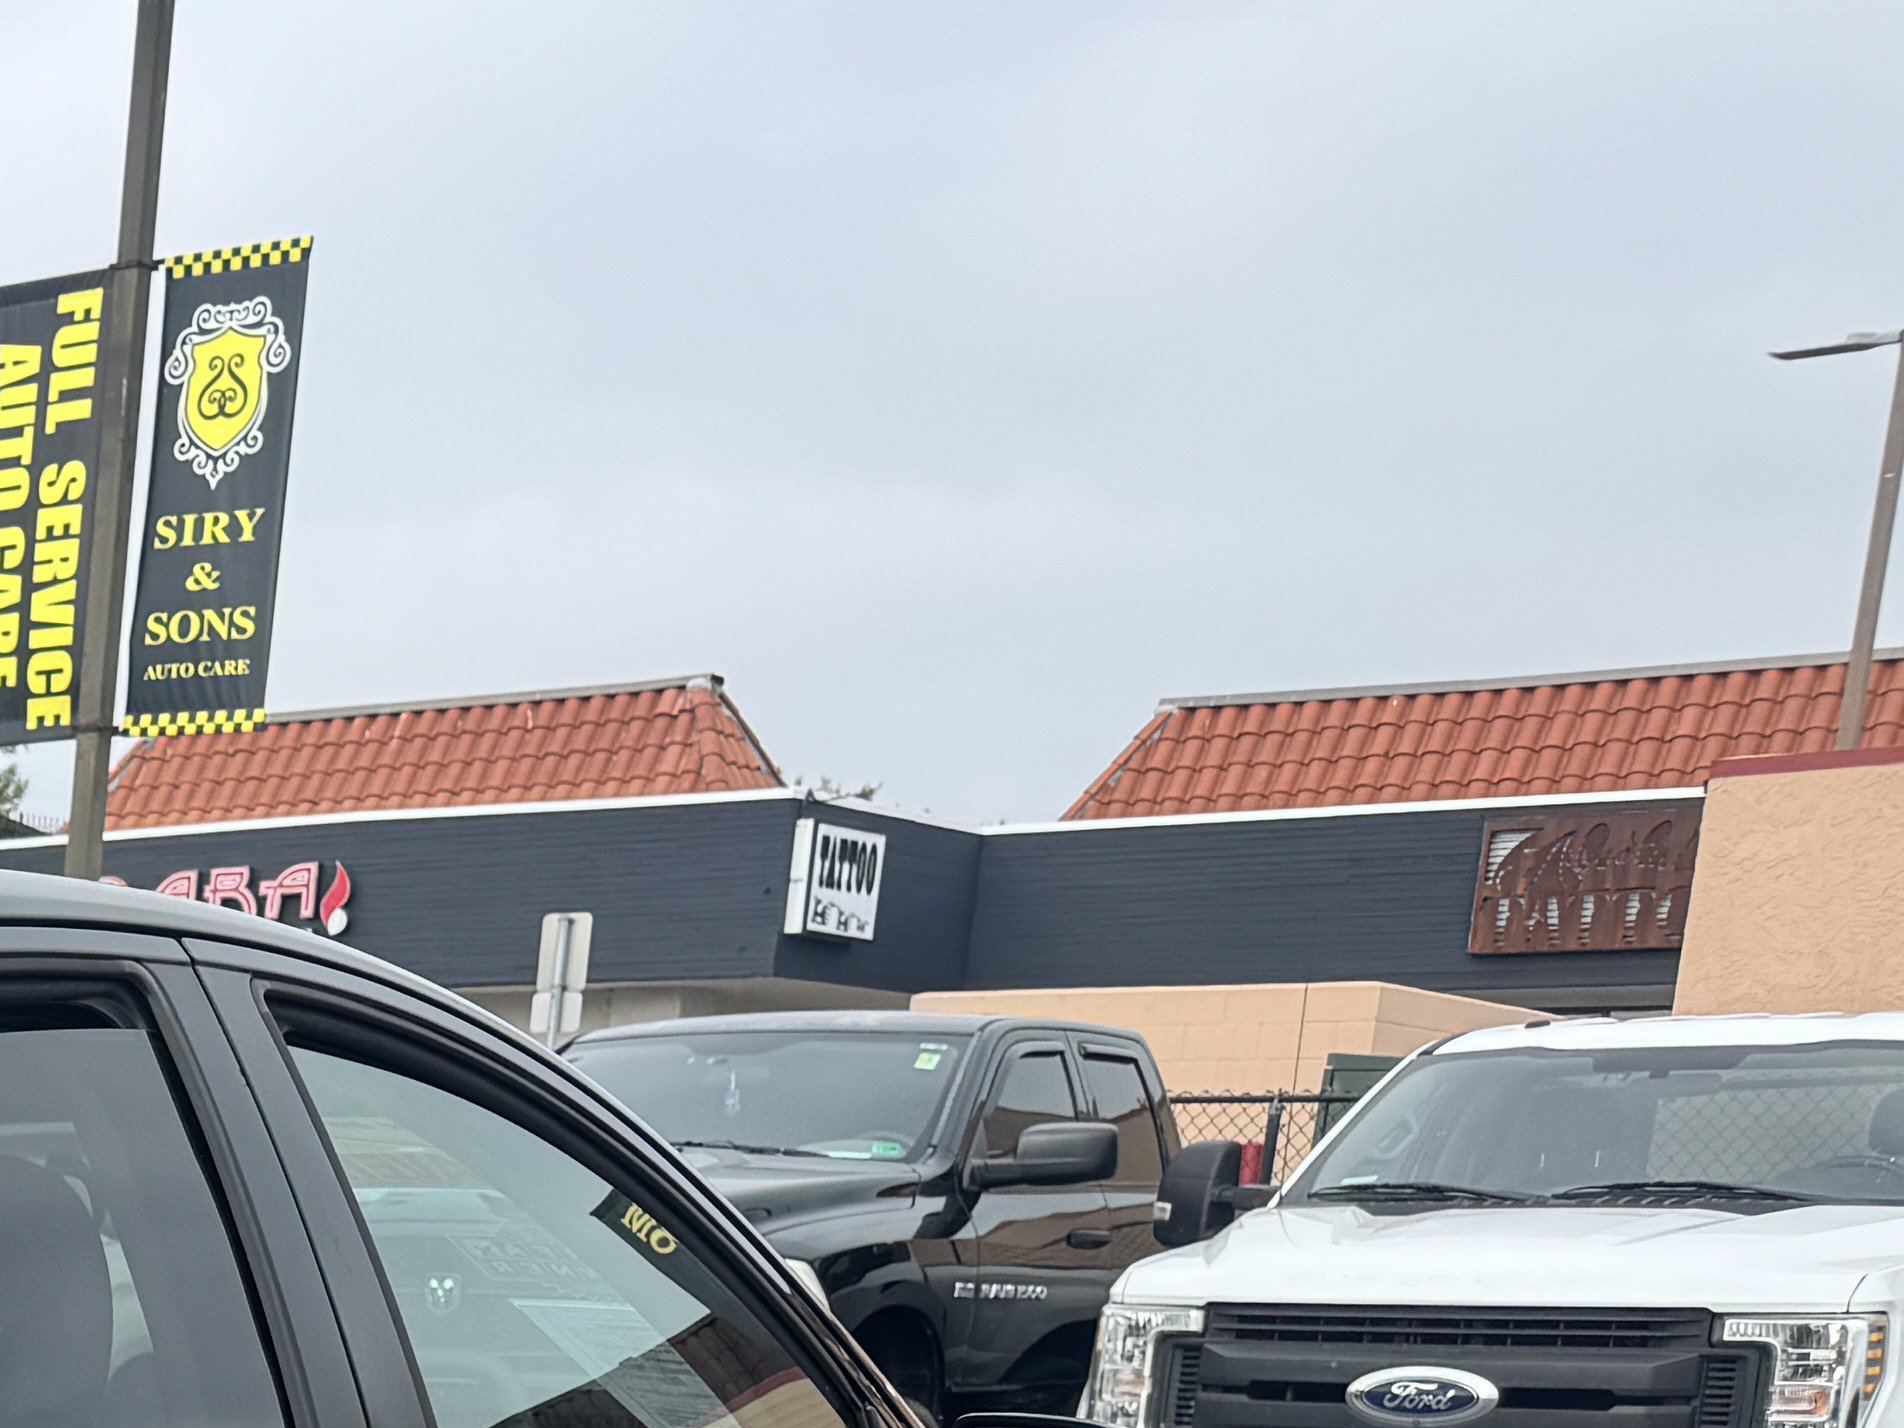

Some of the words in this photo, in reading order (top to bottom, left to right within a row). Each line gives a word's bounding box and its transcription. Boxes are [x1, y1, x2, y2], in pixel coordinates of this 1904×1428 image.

[45, 287, 103, 435] FULL
[153, 507, 266, 550] SIRY
[26, 460, 88, 731] SERVICE
[185, 562, 221, 591] &
[144, 606, 256, 646] SONS
[143, 662, 195, 681] AUTO
[197, 659, 251, 678] CARE
[818, 834, 878, 897] TATTOO
[1382, 1381, 1456, 1410] Ford
